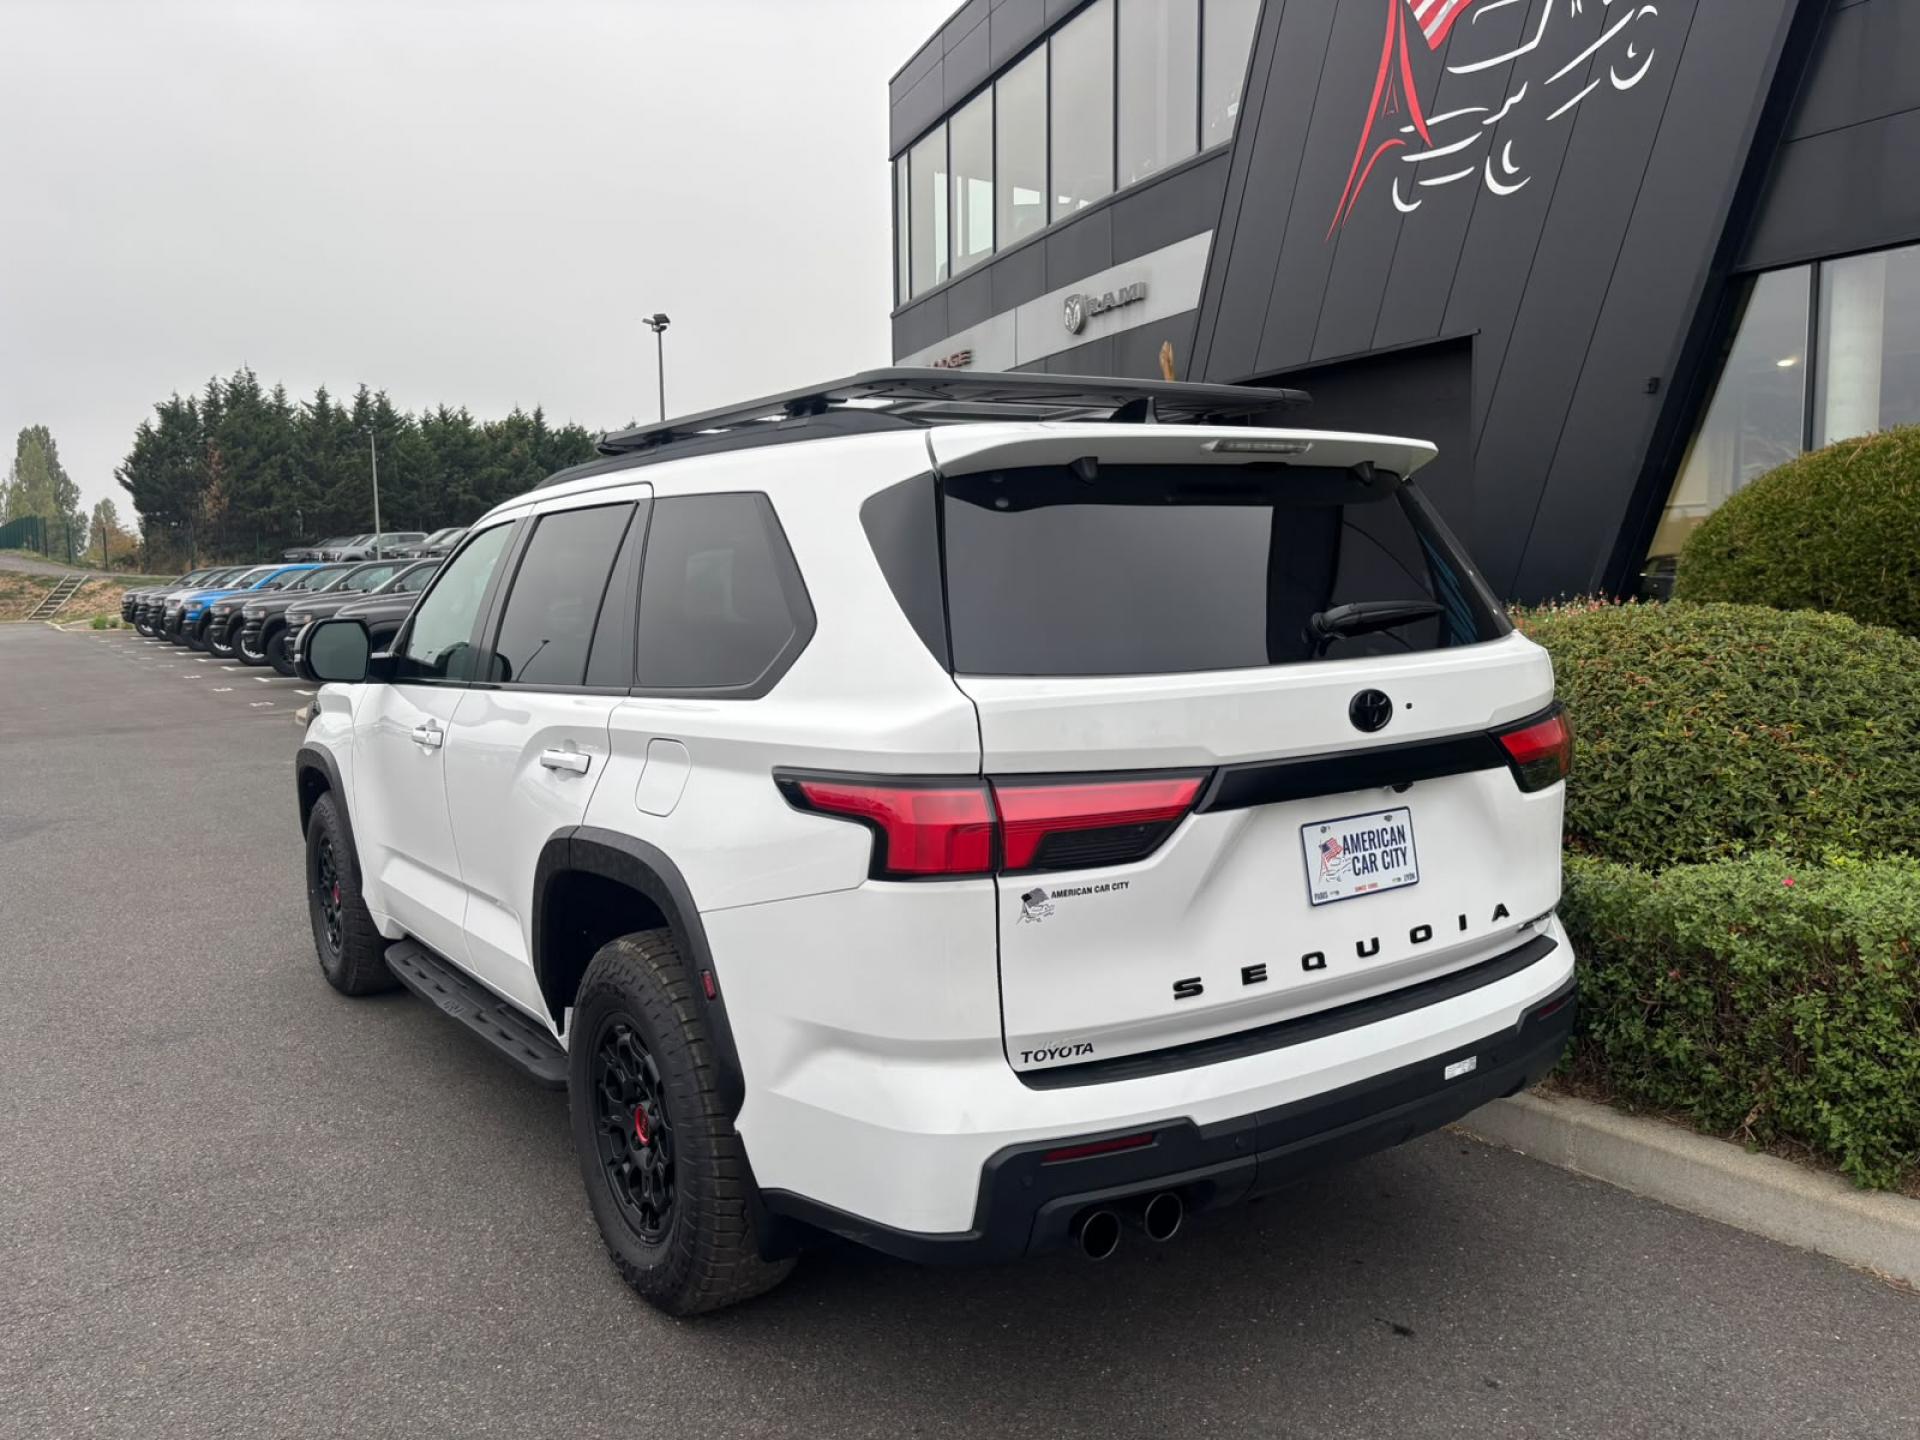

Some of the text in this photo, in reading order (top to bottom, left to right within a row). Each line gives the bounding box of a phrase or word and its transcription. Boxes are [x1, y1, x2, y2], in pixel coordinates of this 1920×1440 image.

[1086, 281, 1149, 317] RAM
[1342, 824, 1407, 856] AMERICAN
[1352, 846, 1408, 876] CAR CITY
[1051, 881, 1130, 899] AMERICAN CAR CITY
[1172, 902, 1511, 1000] SEQUOIA
[1020, 1042, 1094, 1064] TOYOTA
